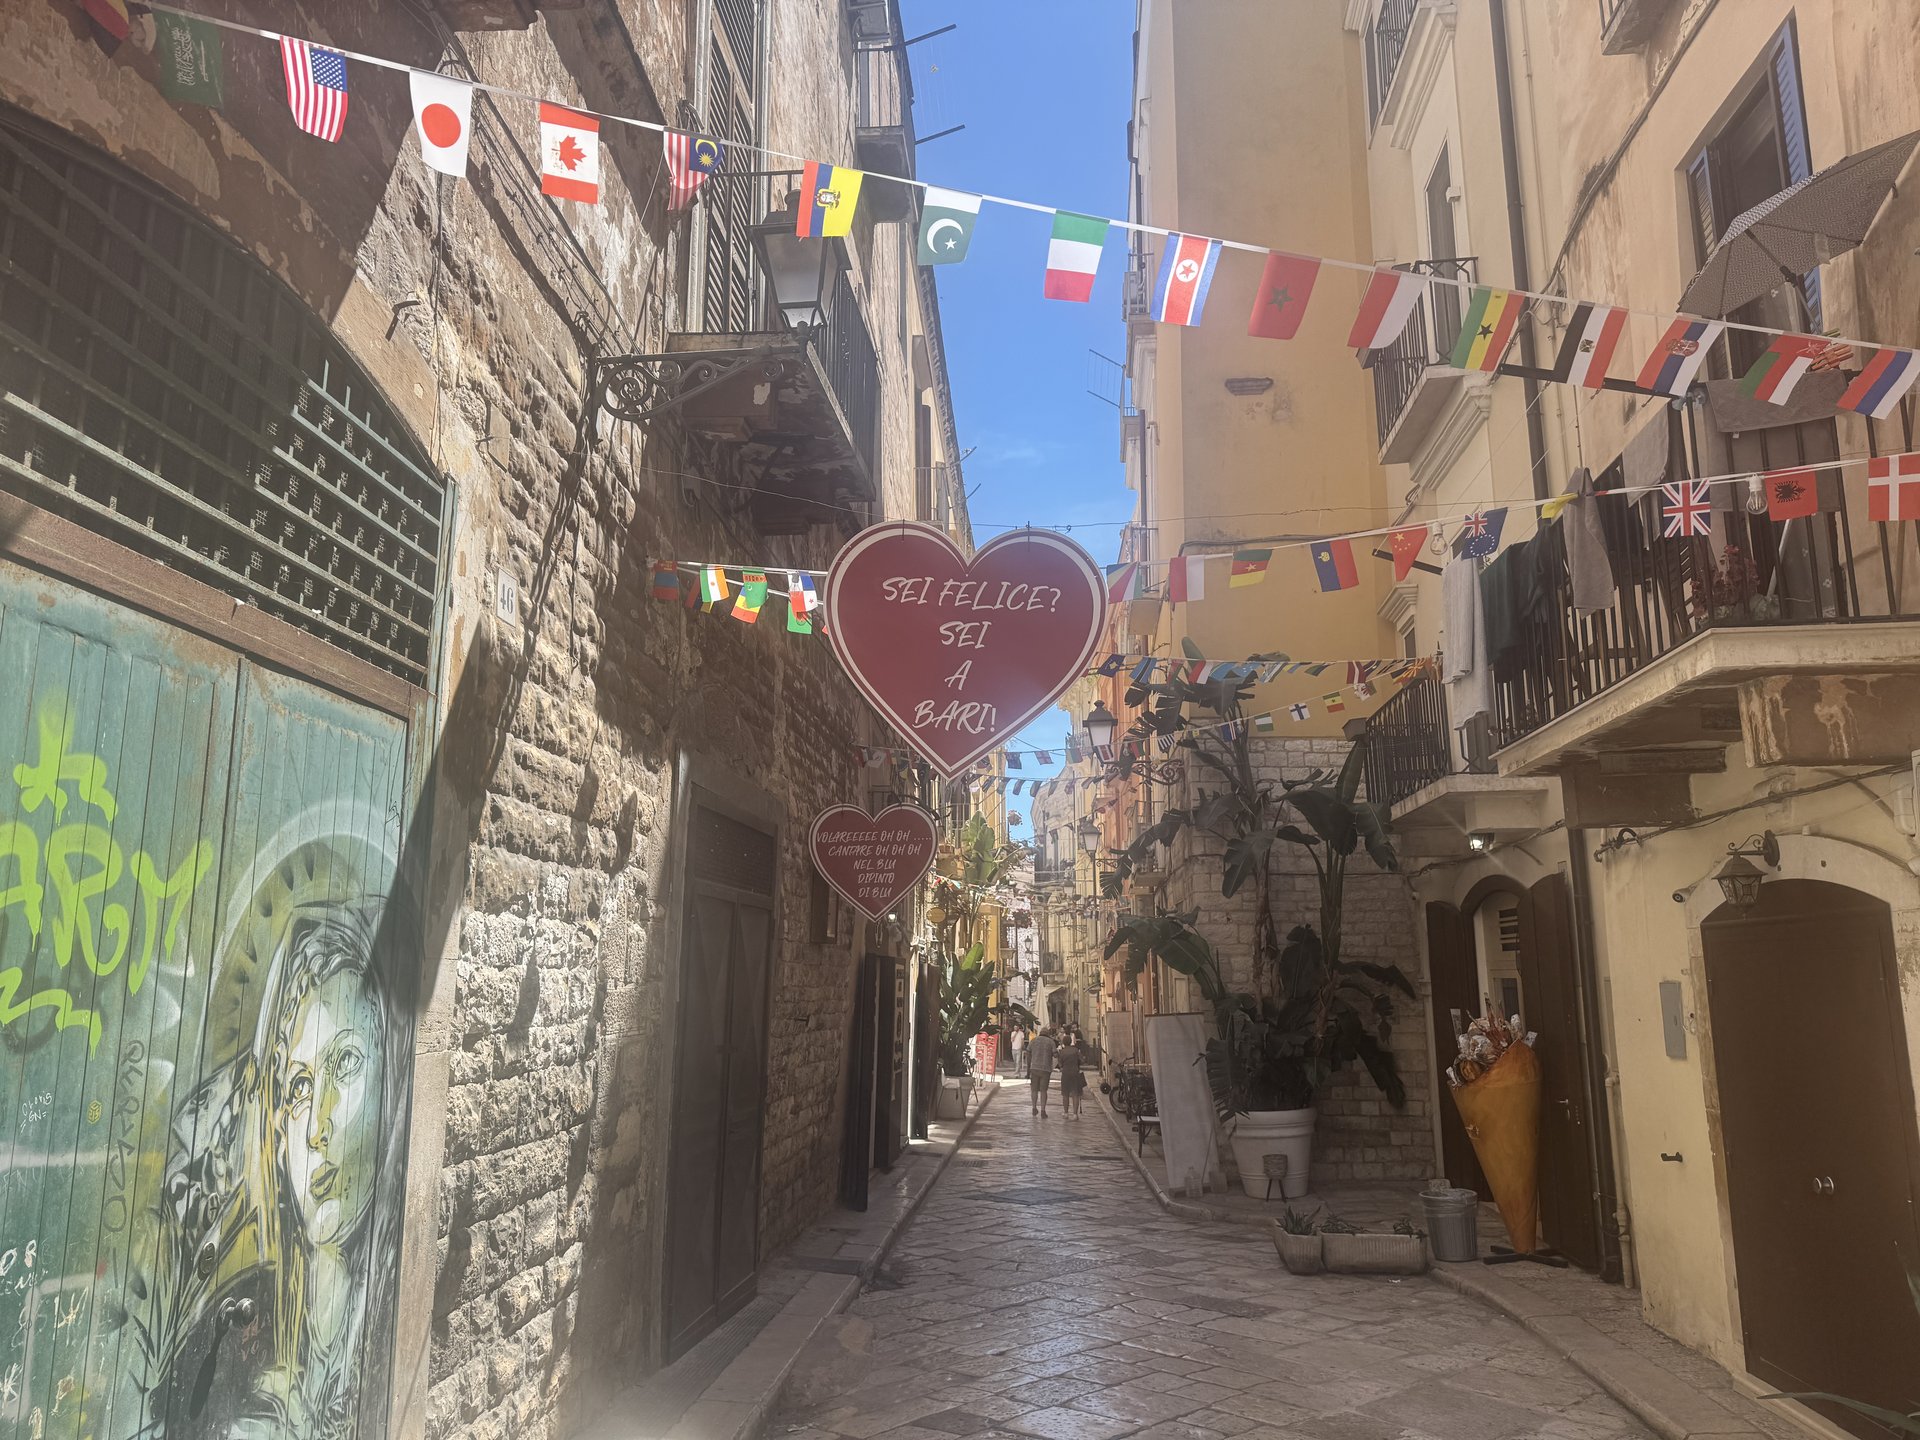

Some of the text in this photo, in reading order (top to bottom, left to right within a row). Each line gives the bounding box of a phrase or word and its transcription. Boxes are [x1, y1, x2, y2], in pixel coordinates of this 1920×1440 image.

[500, 583, 514, 615] 46
[882, 576, 1061, 612] SEI FELICE?
[939, 620, 992, 649] SEI
[944, 659, 973, 690] A
[912, 699, 997, 734] BARI!
[816, 831, 878, 844] VOLAREEEEE
[880, 830, 895, 842] OH
[896, 829, 911, 842] OH
[828, 843, 922, 857] CANTARE OH OH OH
[853, 859, 897, 870] NEL BLU
[858, 872, 895, 884] DIPINTO
[858, 886, 892, 898] DI BLU
